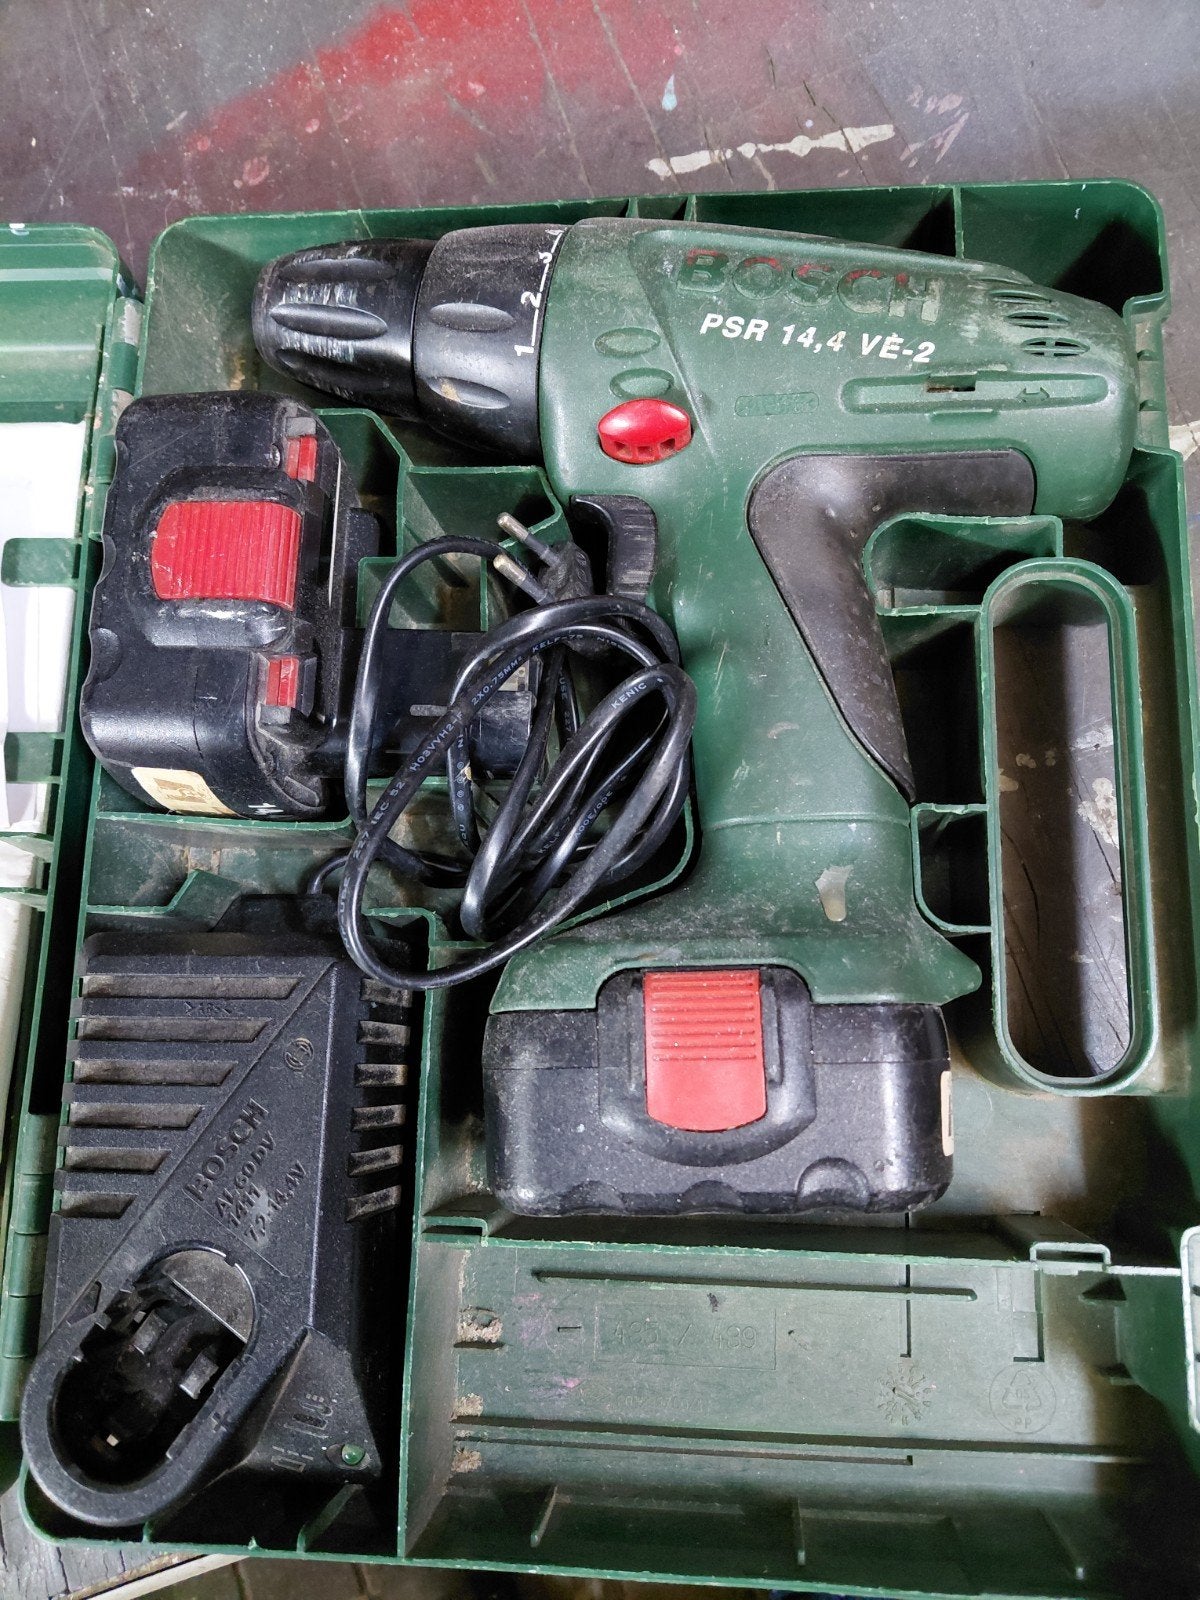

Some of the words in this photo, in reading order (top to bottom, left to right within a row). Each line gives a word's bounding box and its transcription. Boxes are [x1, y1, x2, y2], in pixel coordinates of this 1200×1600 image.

[520, 291, 542, 309] 2
[677, 248, 945, 323] BOSCH
[700, 312, 770, 342] PSR
[782, 324, 847, 353] 14,4
[860, 332, 936, 364] VE-2
[611, 682, 647, 709] KENIC
[371, 801, 390, 825] IEC
[409, 711, 464, 772] H03VVH2-F
[184, 1097, 270, 1202] BOSCH
